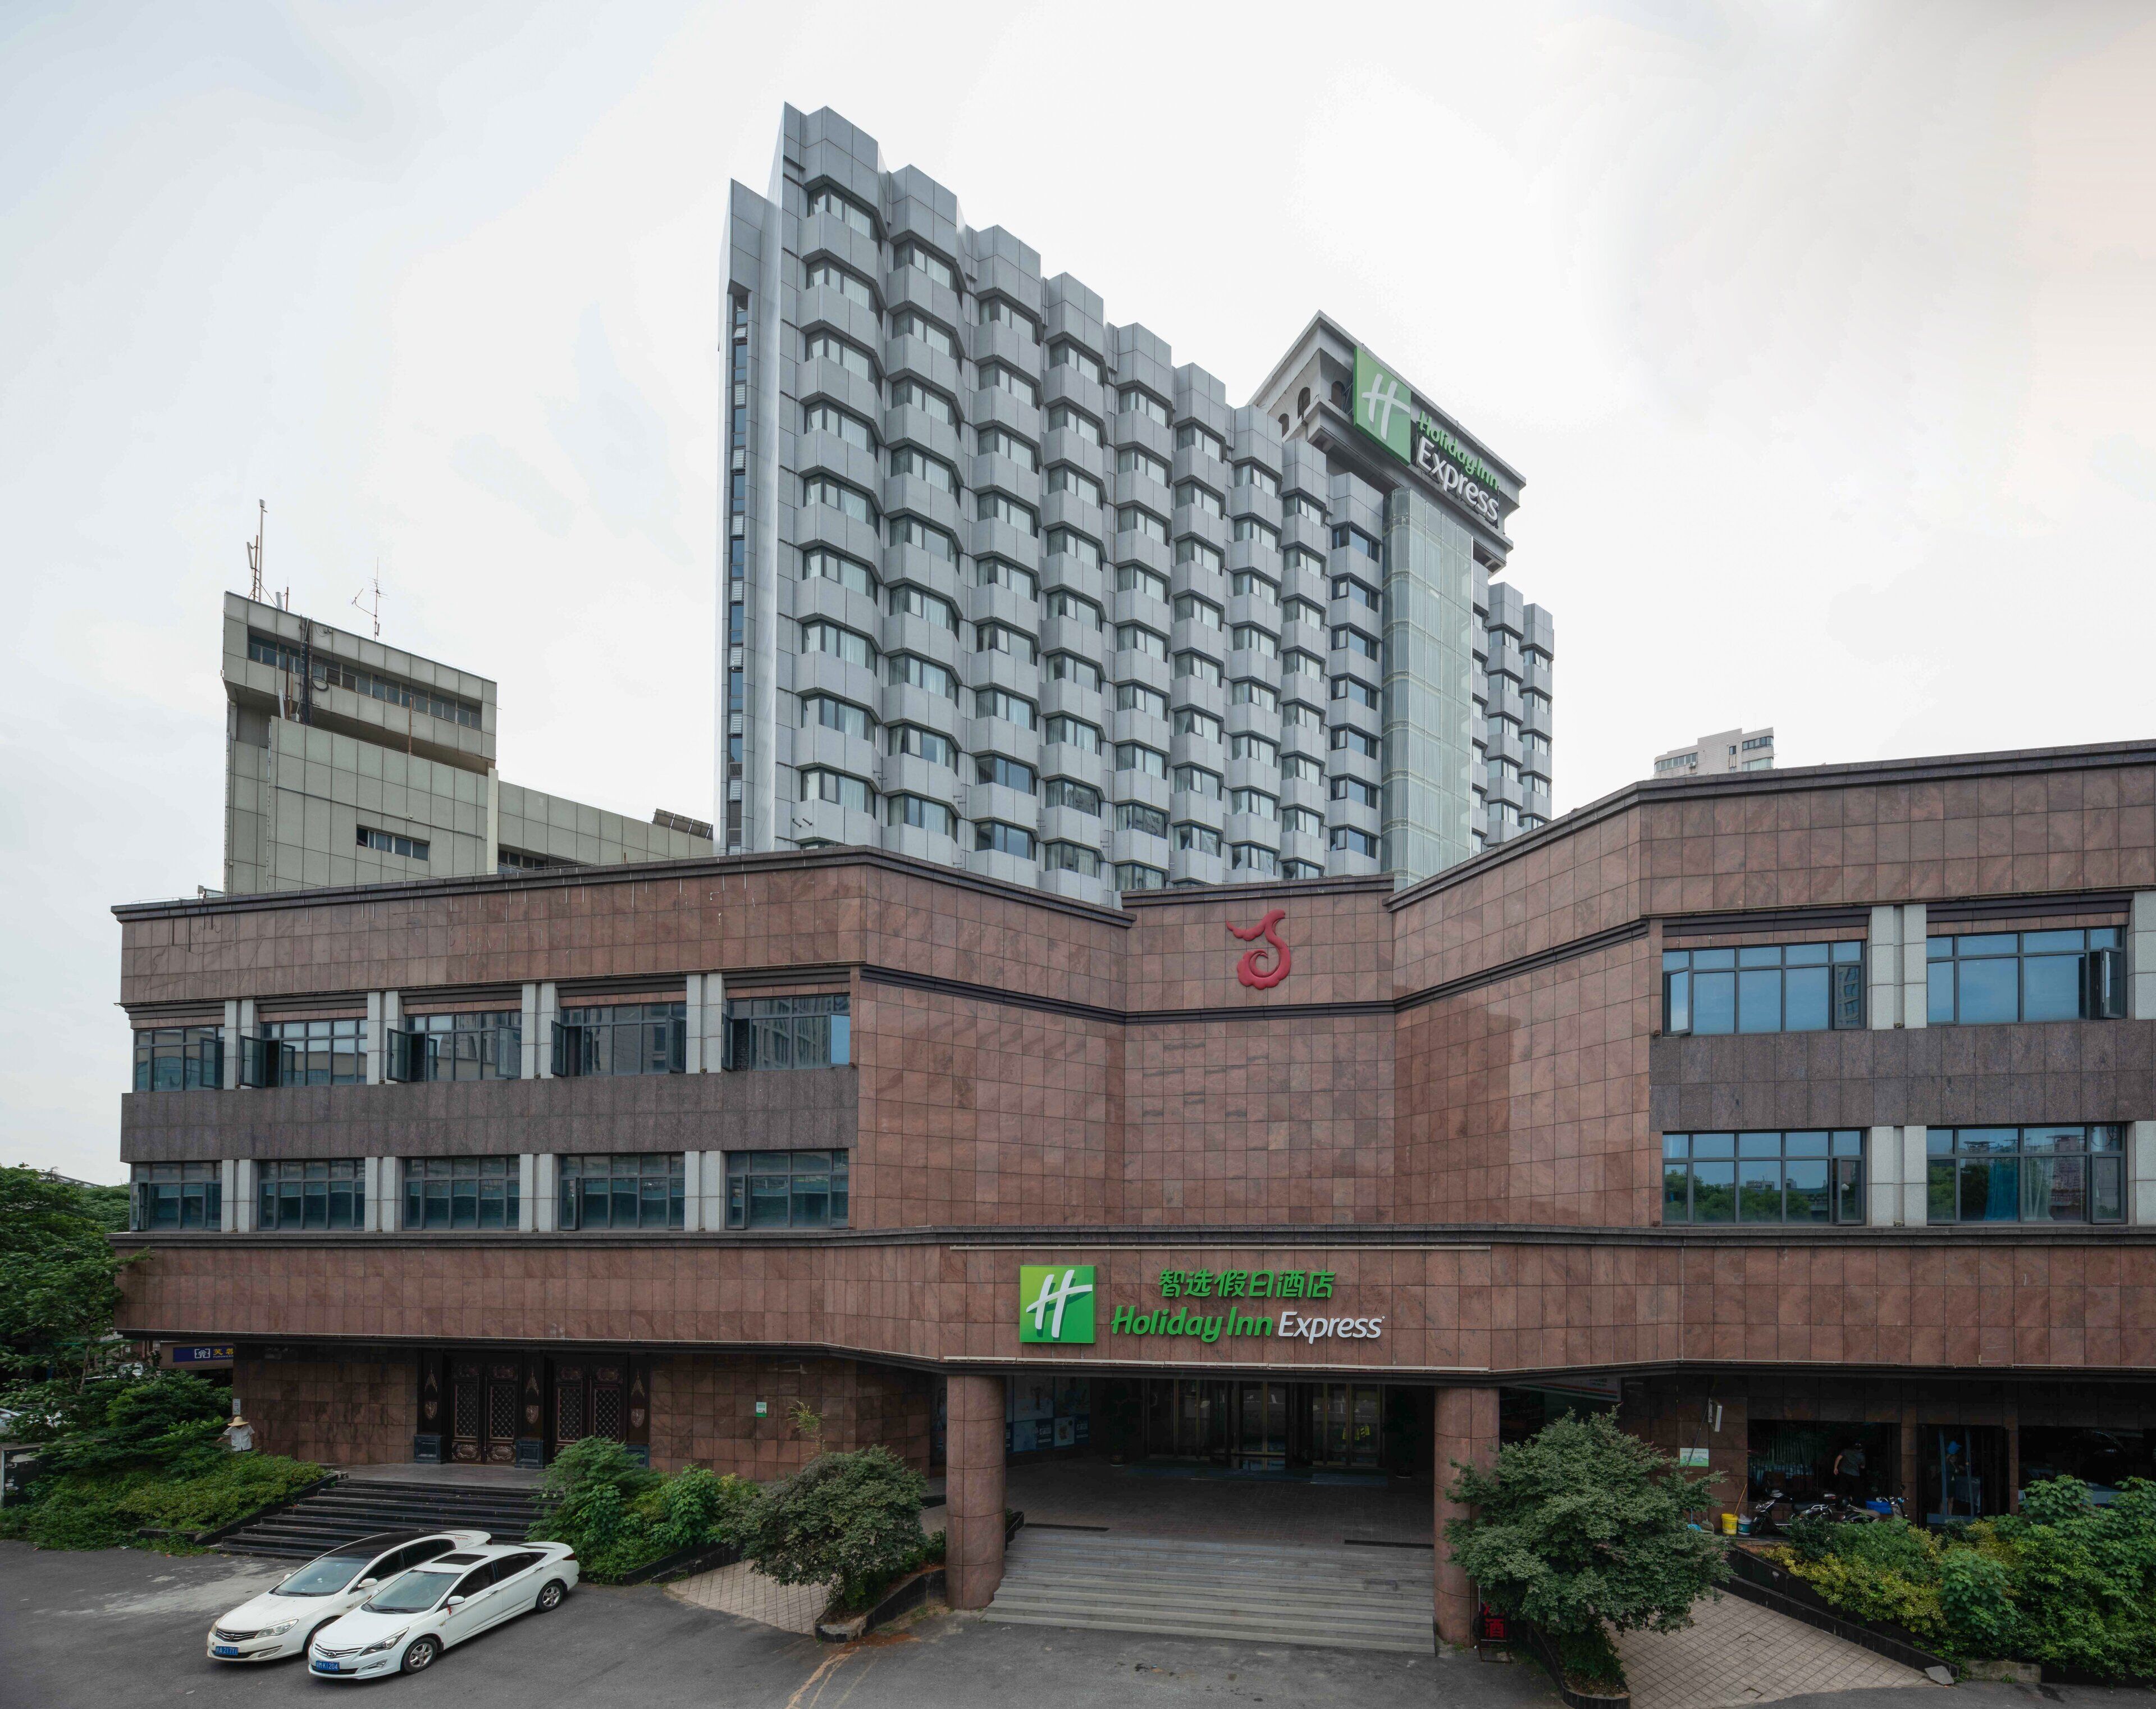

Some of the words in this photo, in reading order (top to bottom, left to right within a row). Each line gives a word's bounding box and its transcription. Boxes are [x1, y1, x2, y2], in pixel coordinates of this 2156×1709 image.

[1417, 436, 1499, 522] Express
[1418, 411, 1475, 475] Holiday
[1476, 457, 1499, 490] Inn
[1158, 1268, 1336, 1298] 智选假日酒店
[1111, 1305, 1223, 1343] Holiday
[1226, 1306, 1273, 1337] Inn
[1278, 1311, 1383, 1345] Express
